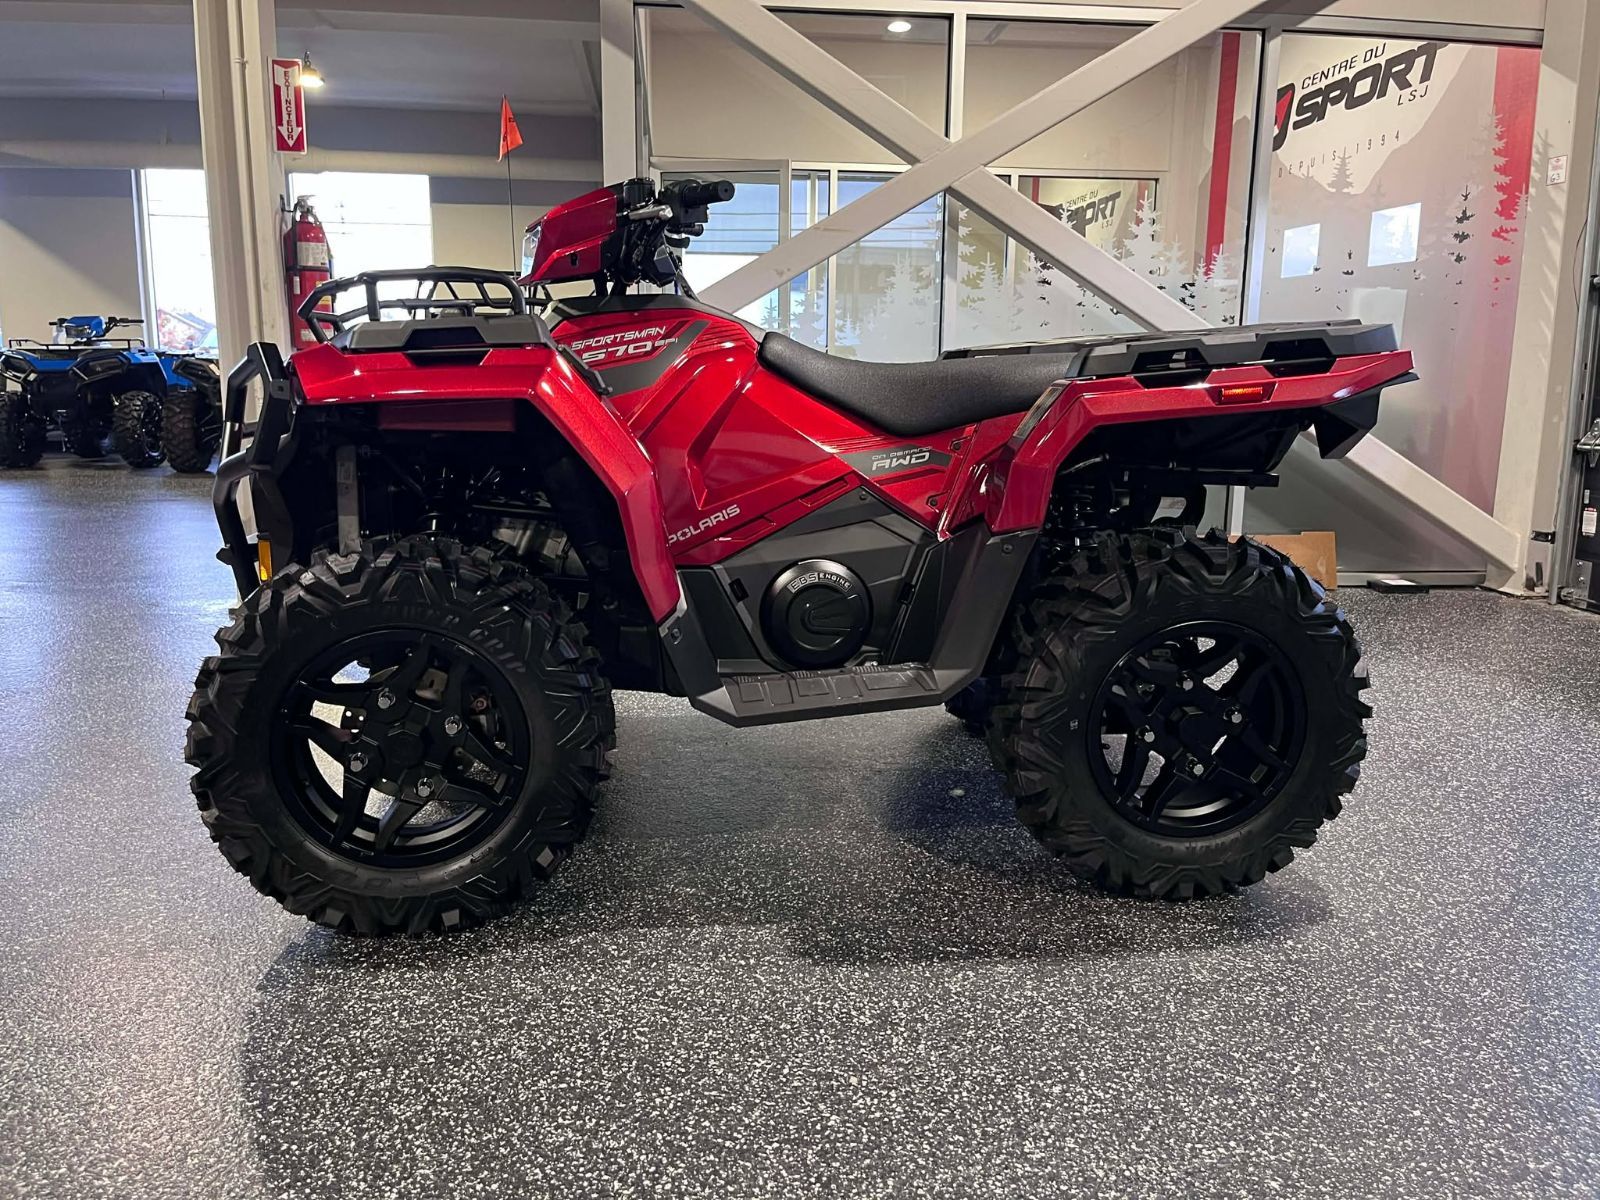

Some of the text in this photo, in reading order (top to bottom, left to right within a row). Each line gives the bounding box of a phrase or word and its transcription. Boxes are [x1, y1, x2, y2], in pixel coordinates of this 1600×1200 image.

[1293, 42, 1448, 130] SPORT
[1302, 42, 1386, 89] CENTRE DU
[283, 70, 294, 141] EXTINCTEUR
[1278, 130, 1400, 178] DEPUIS 1994
[571, 326, 666, 350] SPORTSMAN
[582, 341, 652, 362] 570
[872, 452, 930, 470] AWD
[667, 504, 740, 545] POLARIS
[791, 572, 850, 590] EBS ENGINE
